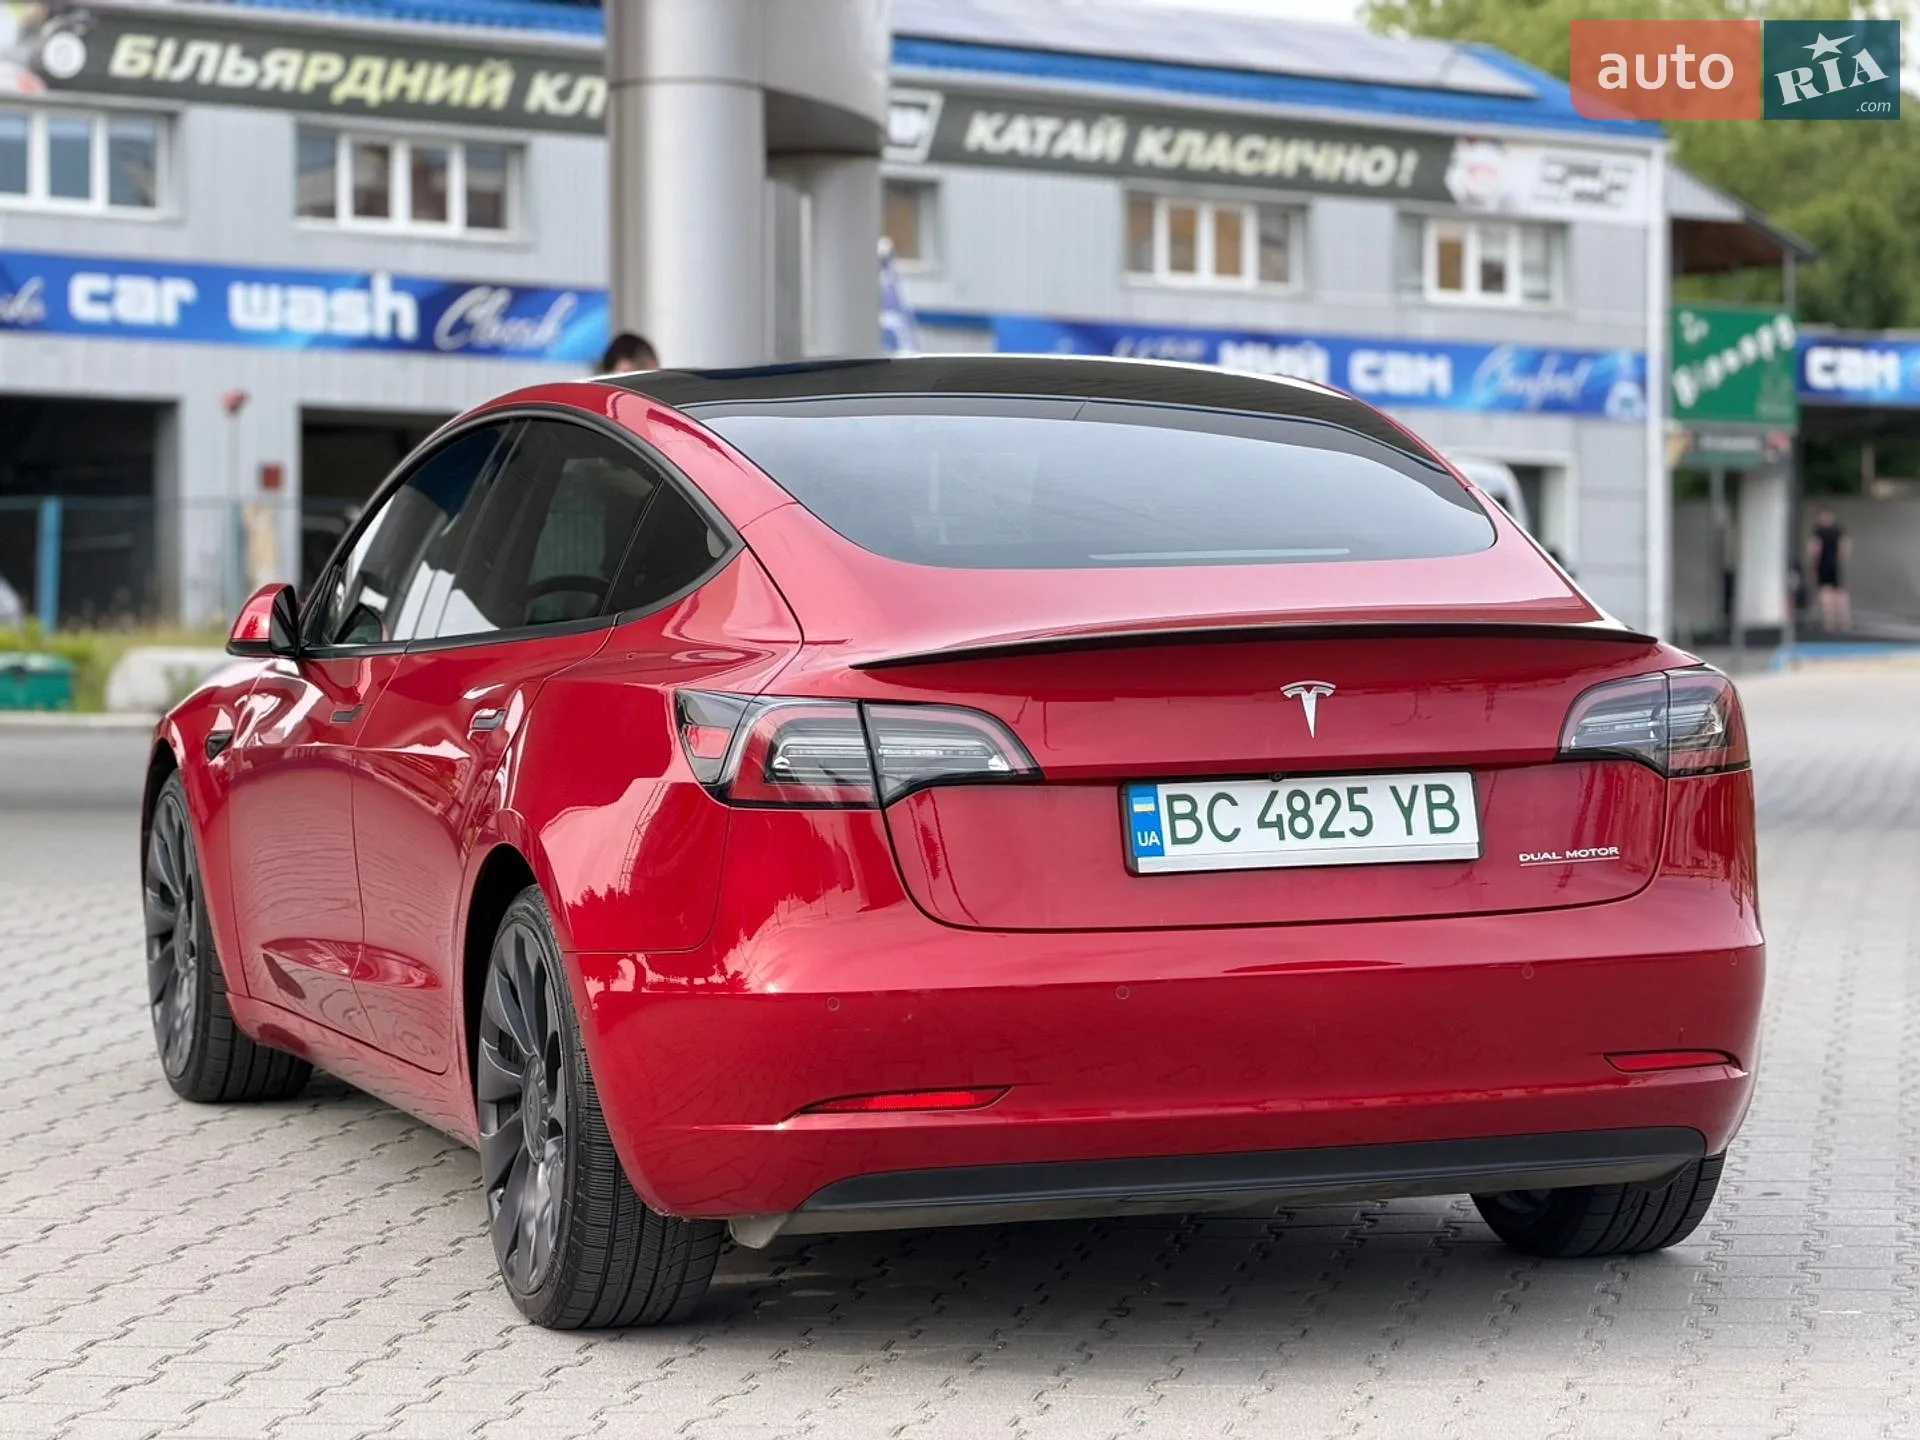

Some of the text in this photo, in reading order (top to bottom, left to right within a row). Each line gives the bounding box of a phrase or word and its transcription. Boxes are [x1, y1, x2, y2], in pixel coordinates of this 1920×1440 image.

[108, 32, 516, 110] БІЛЬЯРДНИЙ
[964, 111, 1420, 188] КАТАЙ КЛАСИЧНО!
[68, 272, 198, 328] car
[227, 270, 420, 343] wash
[1136, 830, 1160, 847] UA
[1165, 783, 1460, 846] BC 4825 YB
[1518, 846, 1620, 862] DUAL MOTOR
